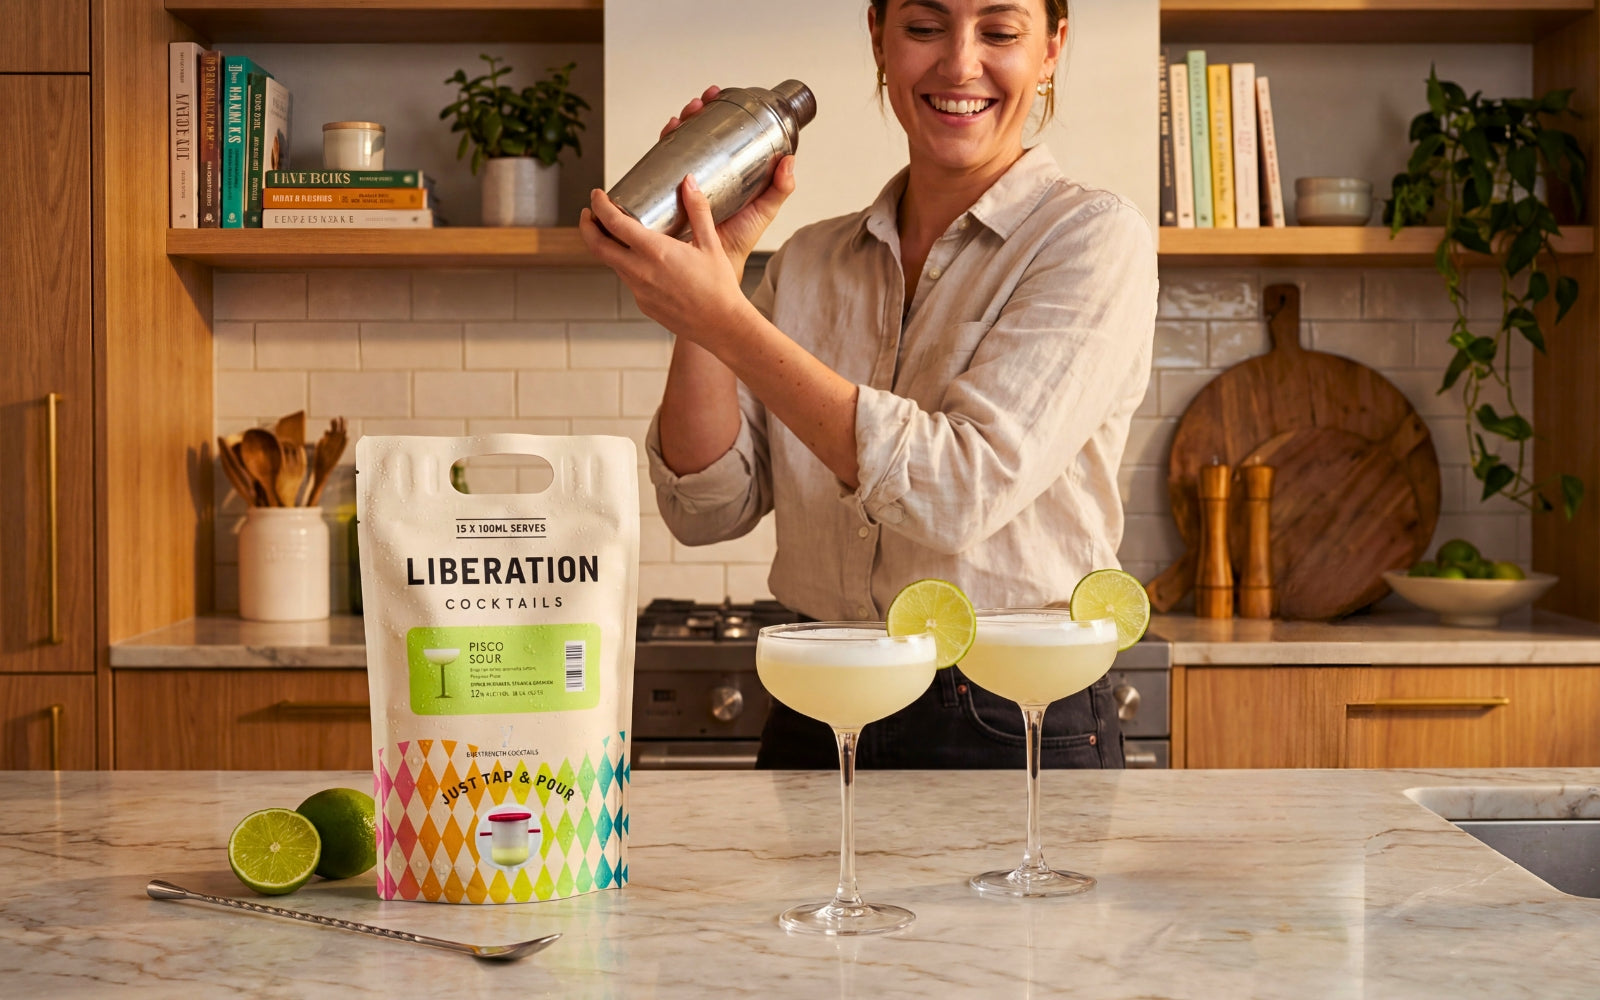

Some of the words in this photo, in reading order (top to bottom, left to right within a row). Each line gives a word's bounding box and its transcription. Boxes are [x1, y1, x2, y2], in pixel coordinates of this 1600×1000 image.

[456, 524, 467, 533] 15
[469, 524, 476, 533] X
[479, 524, 508, 533] 100ML
[510, 523, 546, 533] SERVES
[406, 555, 599, 586] LIBERATION
[445, 596, 563, 610] COCKTAILS
[469, 641, 504, 652] PISCO
[469, 653, 502, 664] SOUR
[441, 777, 477, 805] JUST
[481, 770, 513, 785] TAP
[519, 771, 530, 785] &
[535, 774, 575, 801] POUR
